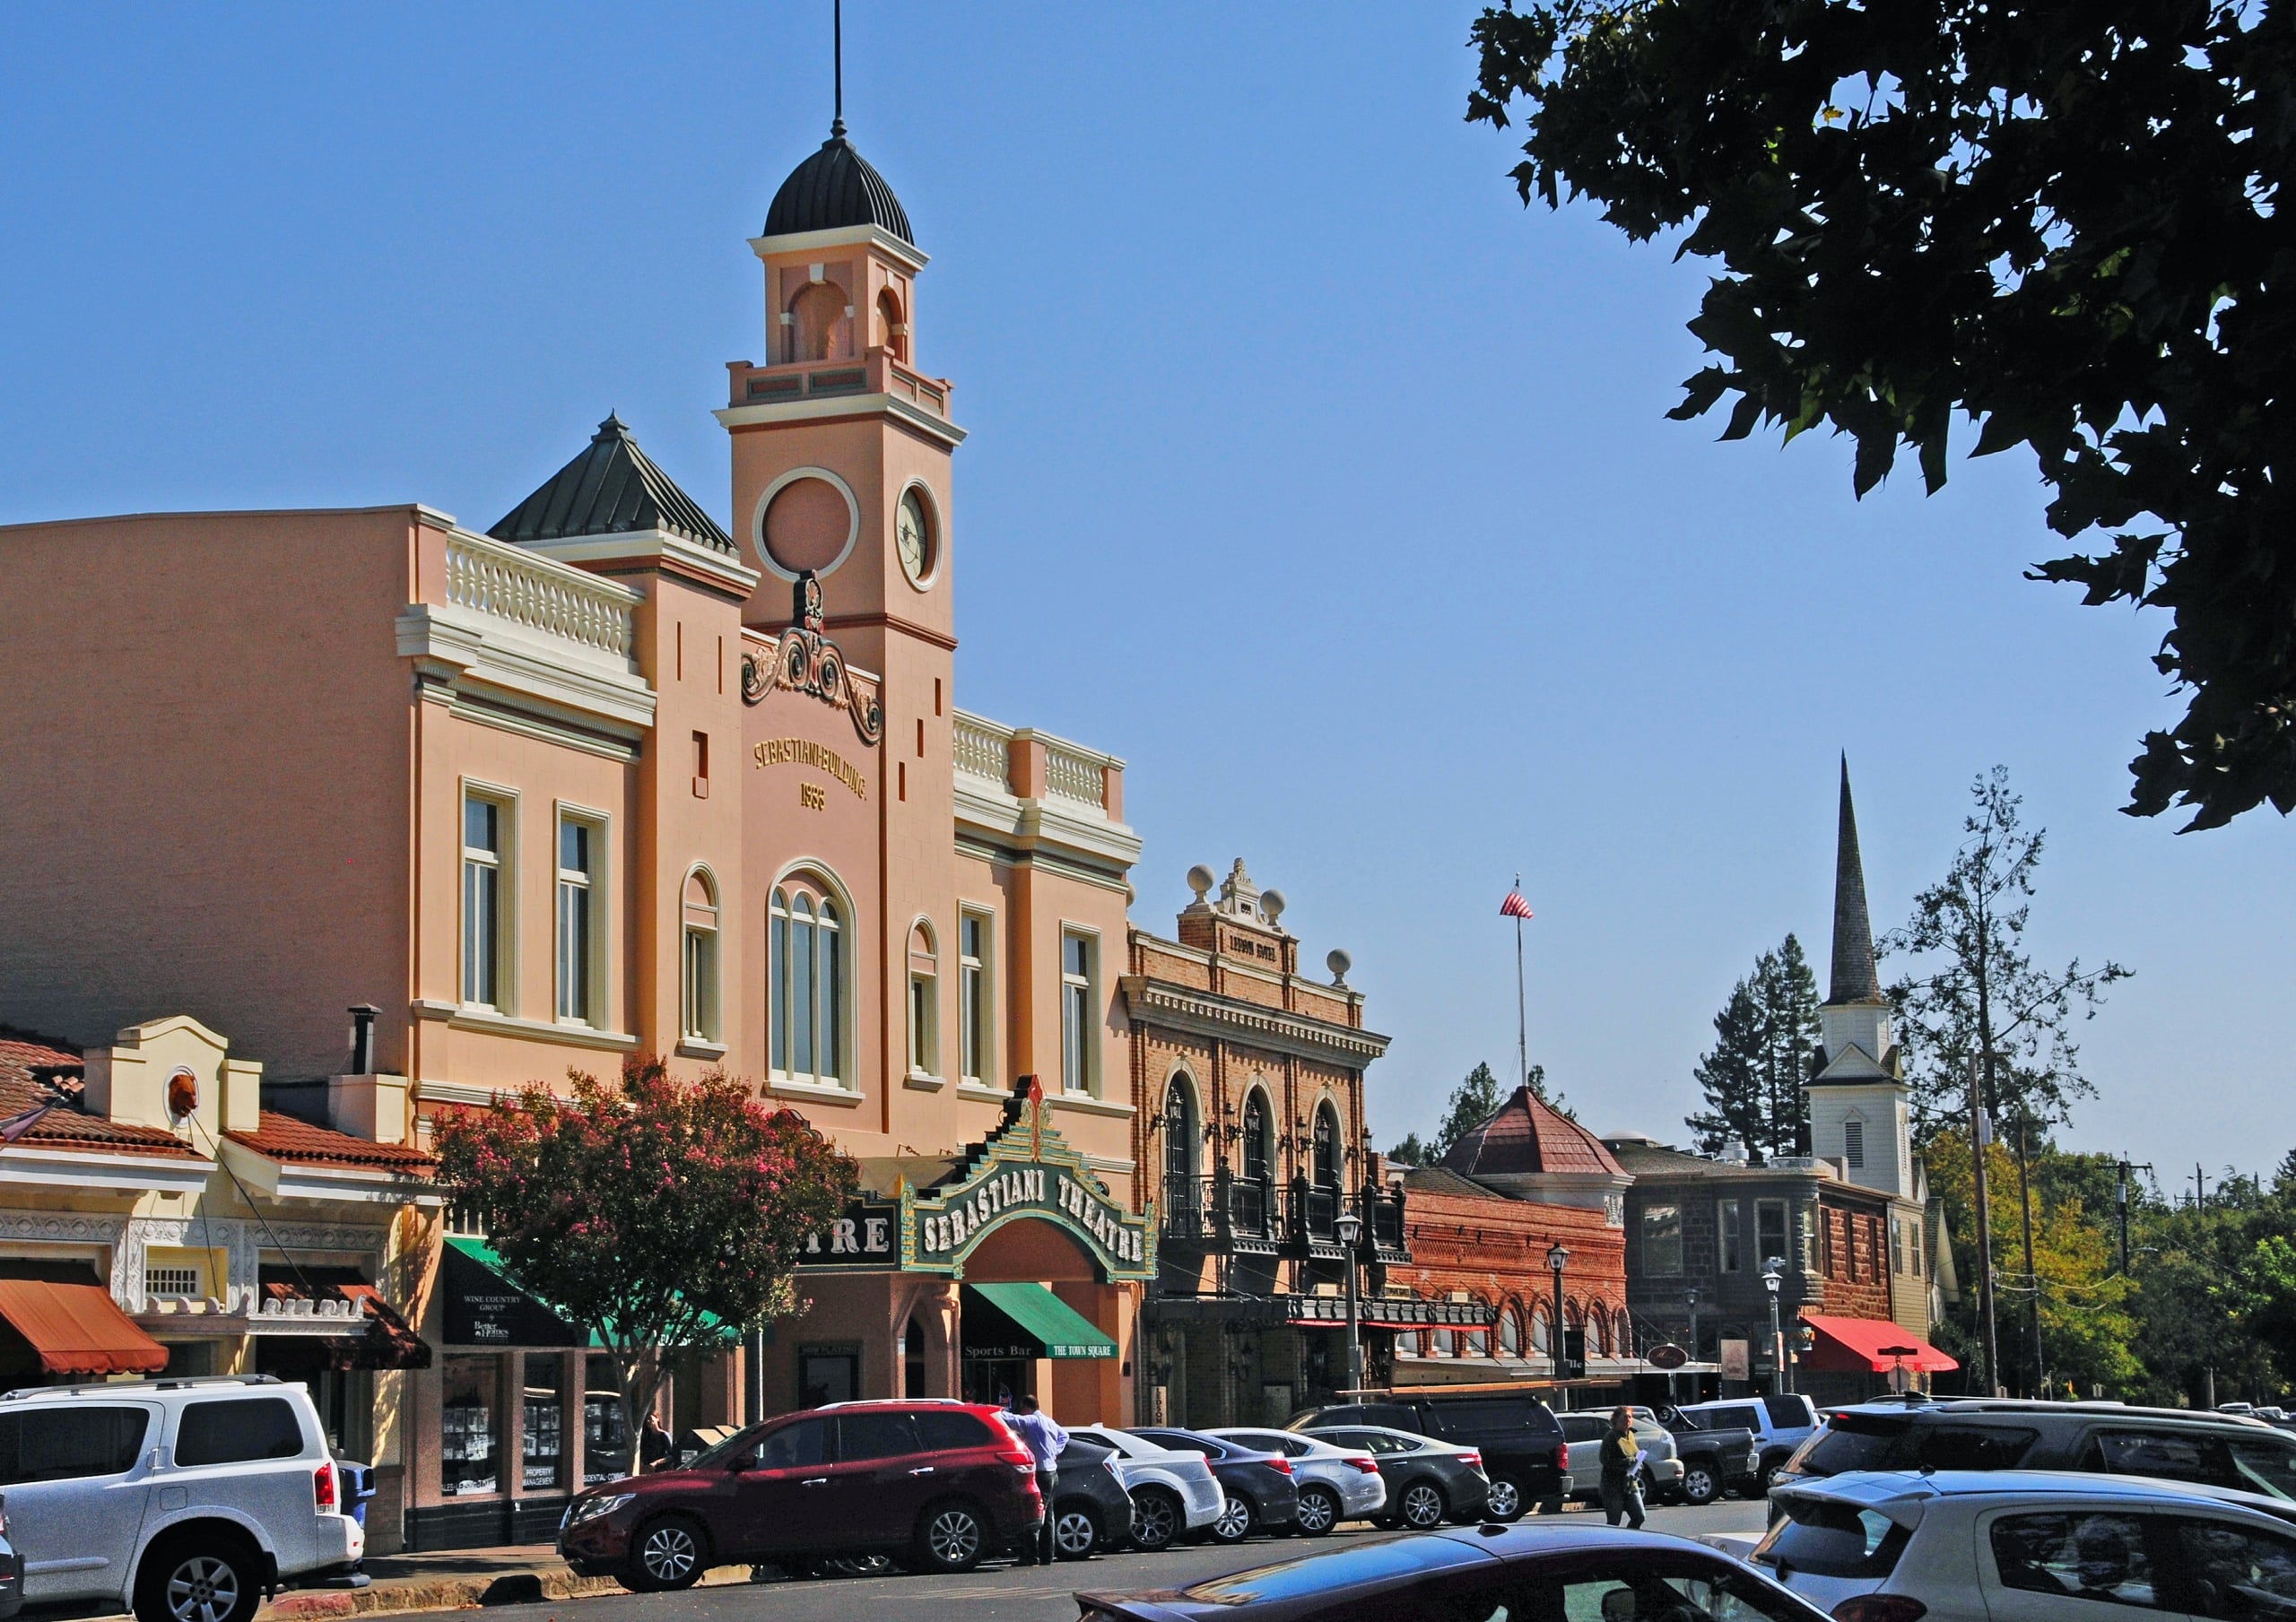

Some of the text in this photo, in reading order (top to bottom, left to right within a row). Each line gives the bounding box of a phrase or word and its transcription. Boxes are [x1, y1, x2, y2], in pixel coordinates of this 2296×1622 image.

[923, 1168, 1144, 1262] SEBASTIANI THEATRE
[485, 1296, 520, 1304] COUNTRY
[479, 1304, 505, 1312] GROUP
[474, 1321, 498, 1330] Better
[482, 1329, 509, 1338] Homes
[965, 1346, 1032, 1358] Sports Bar
[1053, 1345, 1111, 1357] THE TOWN SQUARE
[1155, 1387, 1163, 1424] LEDSON
[526, 1467, 552, 1477] PROPERTY
